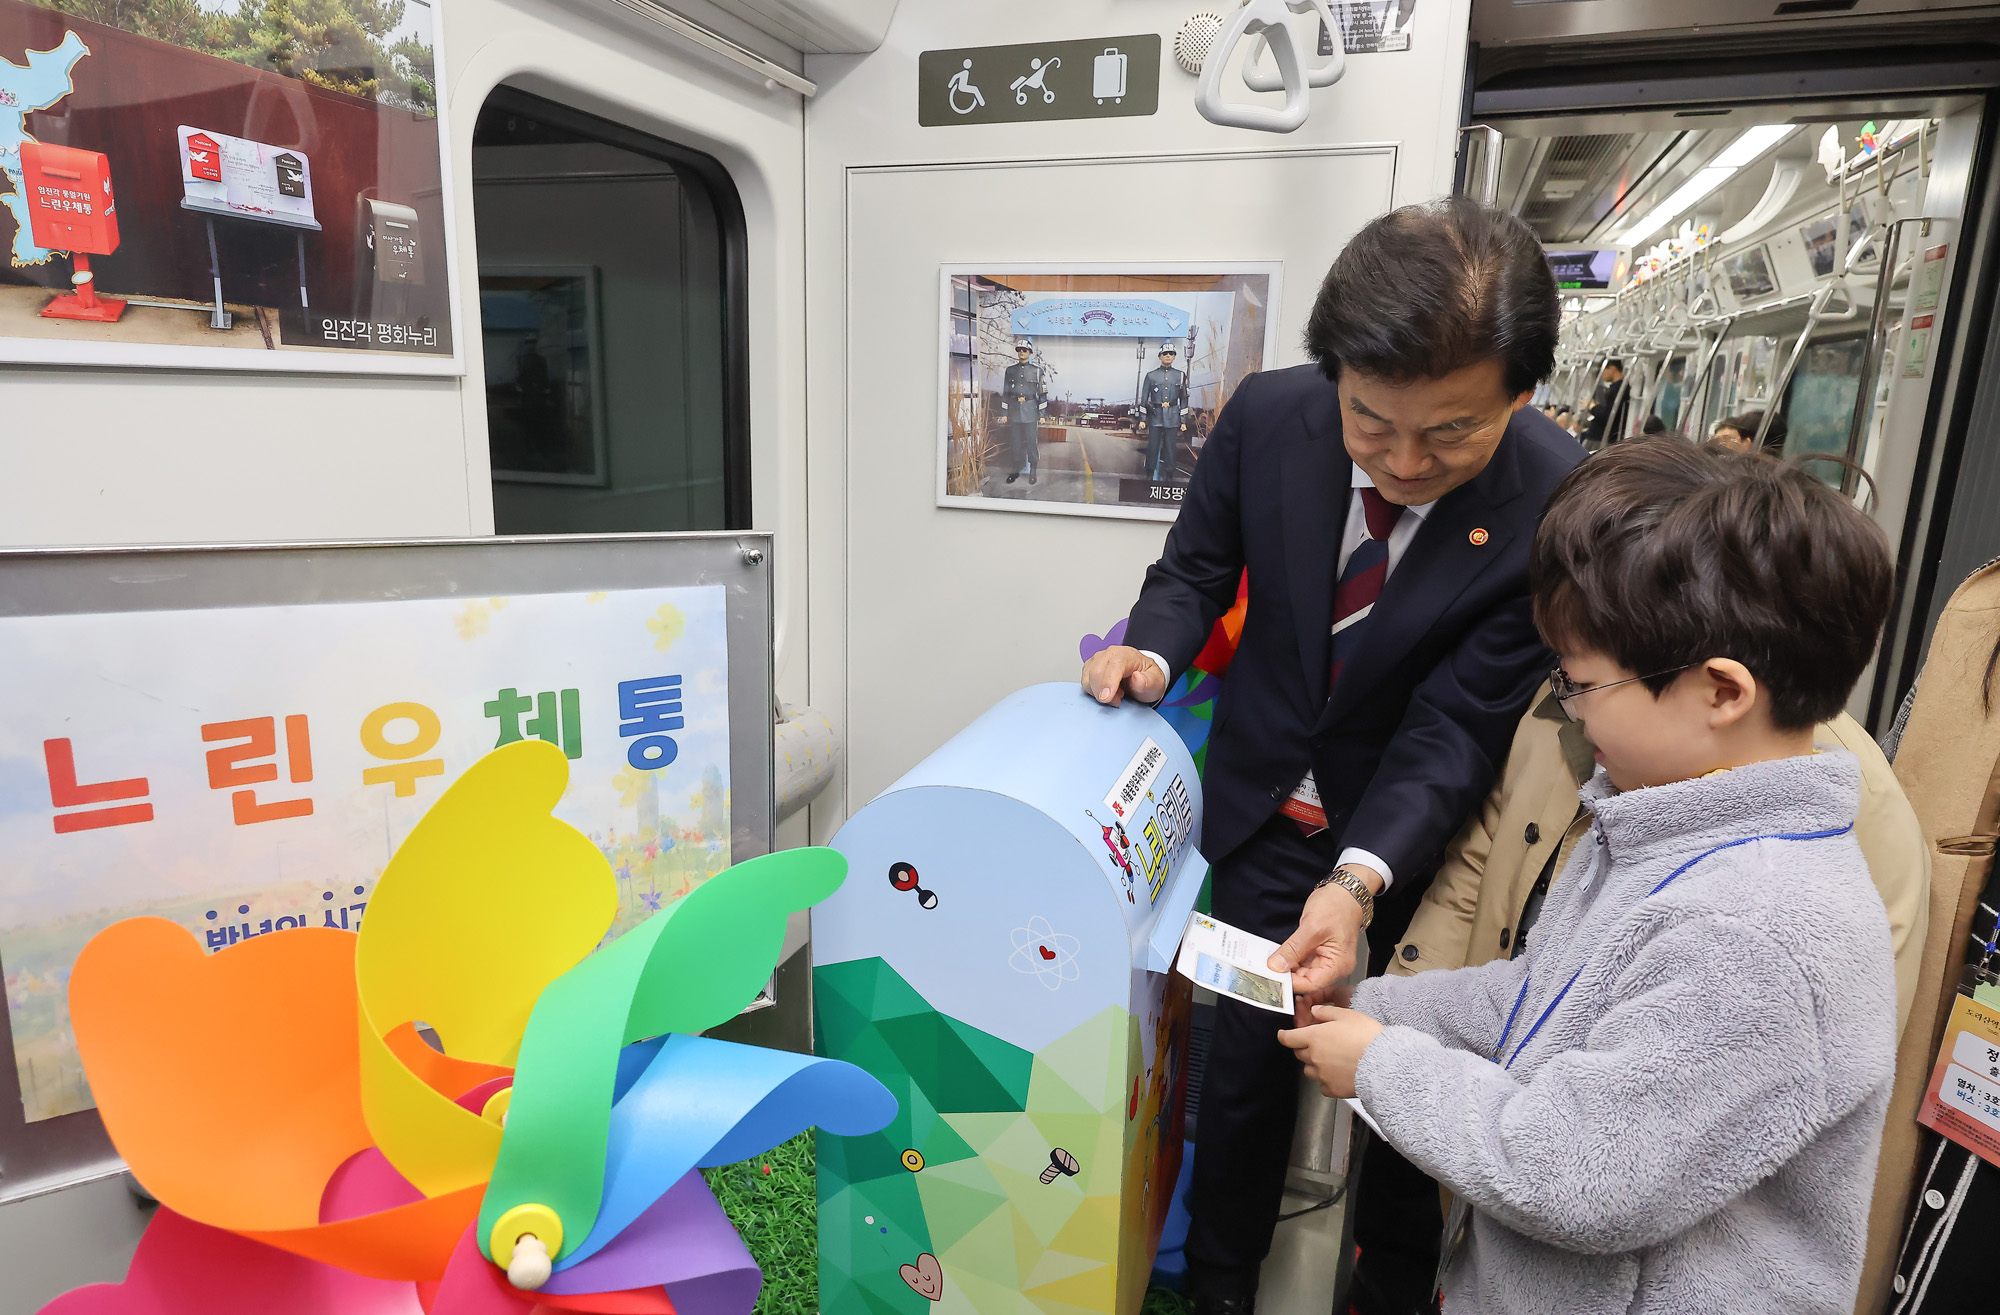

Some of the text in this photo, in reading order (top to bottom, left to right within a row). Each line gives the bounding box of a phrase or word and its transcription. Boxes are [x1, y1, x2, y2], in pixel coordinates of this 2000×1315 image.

[37, 186, 91, 202] 임진각 통일기원
[40, 197, 92, 215] 느린우체통
[1031, 303, 1063, 317] WELCOME
[1102, 301, 1145, 312] INFILTRATION
[322, 319, 437, 347] 임진각 평화누리
[1149, 486, 1188, 501] 제3땅
[1957, 1078, 1976, 1093] 열차
[1956, 1090, 1975, 1105] 버스
